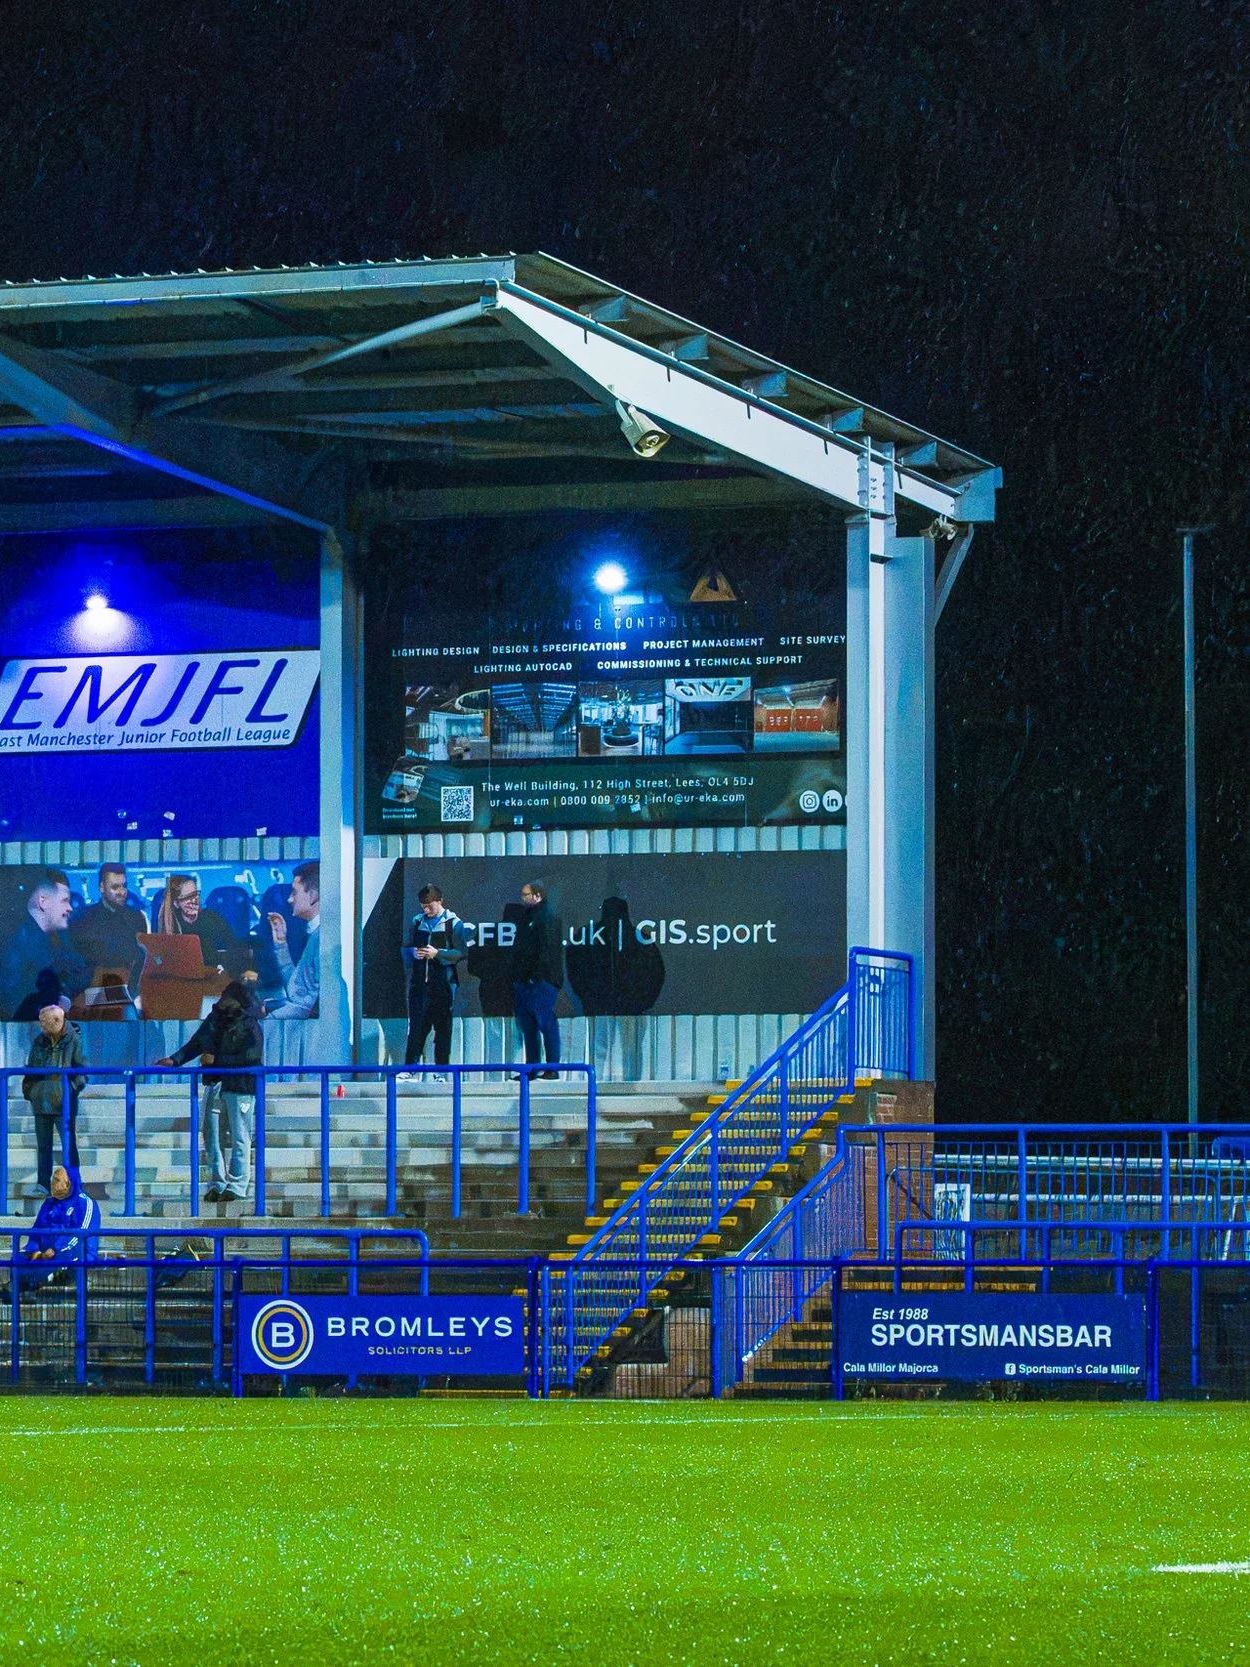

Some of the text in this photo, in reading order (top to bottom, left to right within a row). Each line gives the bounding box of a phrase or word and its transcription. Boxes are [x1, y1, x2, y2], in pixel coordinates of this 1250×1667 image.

[643, 637, 764, 650] PROJECT MANAGEMENT
[779, 635, 846, 645] SITE SURVEY
[391, 646, 480, 657] LIGHTING DESIGN
[492, 645, 529, 654] DESIGN
[542, 641, 627, 653] SPECIFICATIONS
[473, 662, 573, 674] LIGHTING AUTOCAD
[597, 655, 803, 670] COMMISSIONING & TECHNICAL SUPPORT
[27, 731, 114, 747] Manchester
[117, 730, 166, 747] Junior
[171, 726, 231, 744] Football
[236, 726, 291, 744] League
[481, 776, 754, 792] The Well Building, 112 High Street, Lees, OL4 5DJ
[489, 797, 549, 808] ur-eka.com
[560, 796, 587, 806] 0800
[591, 795, 610, 805] 009
[651, 791, 745, 806] info@ur-eka.com
[635, 919, 777, 950] GIS.sport
[872, 1307, 929, 1320] Est 1988
[327, 1316, 513, 1337] BROMLEYS
[271, 1322, 296, 1348] B
[871, 1323, 1112, 1348] SPORTSMANSBAR
[367, 1346, 473, 1355] SOLICITORS LLP
[843, 1362, 939, 1375] Cala Millor Majorca
[1018, 1363, 1083, 1375] Sportsman's
[1085, 1364, 1108, 1375] Cala
[1110, 1364, 1140, 1375] Millor
